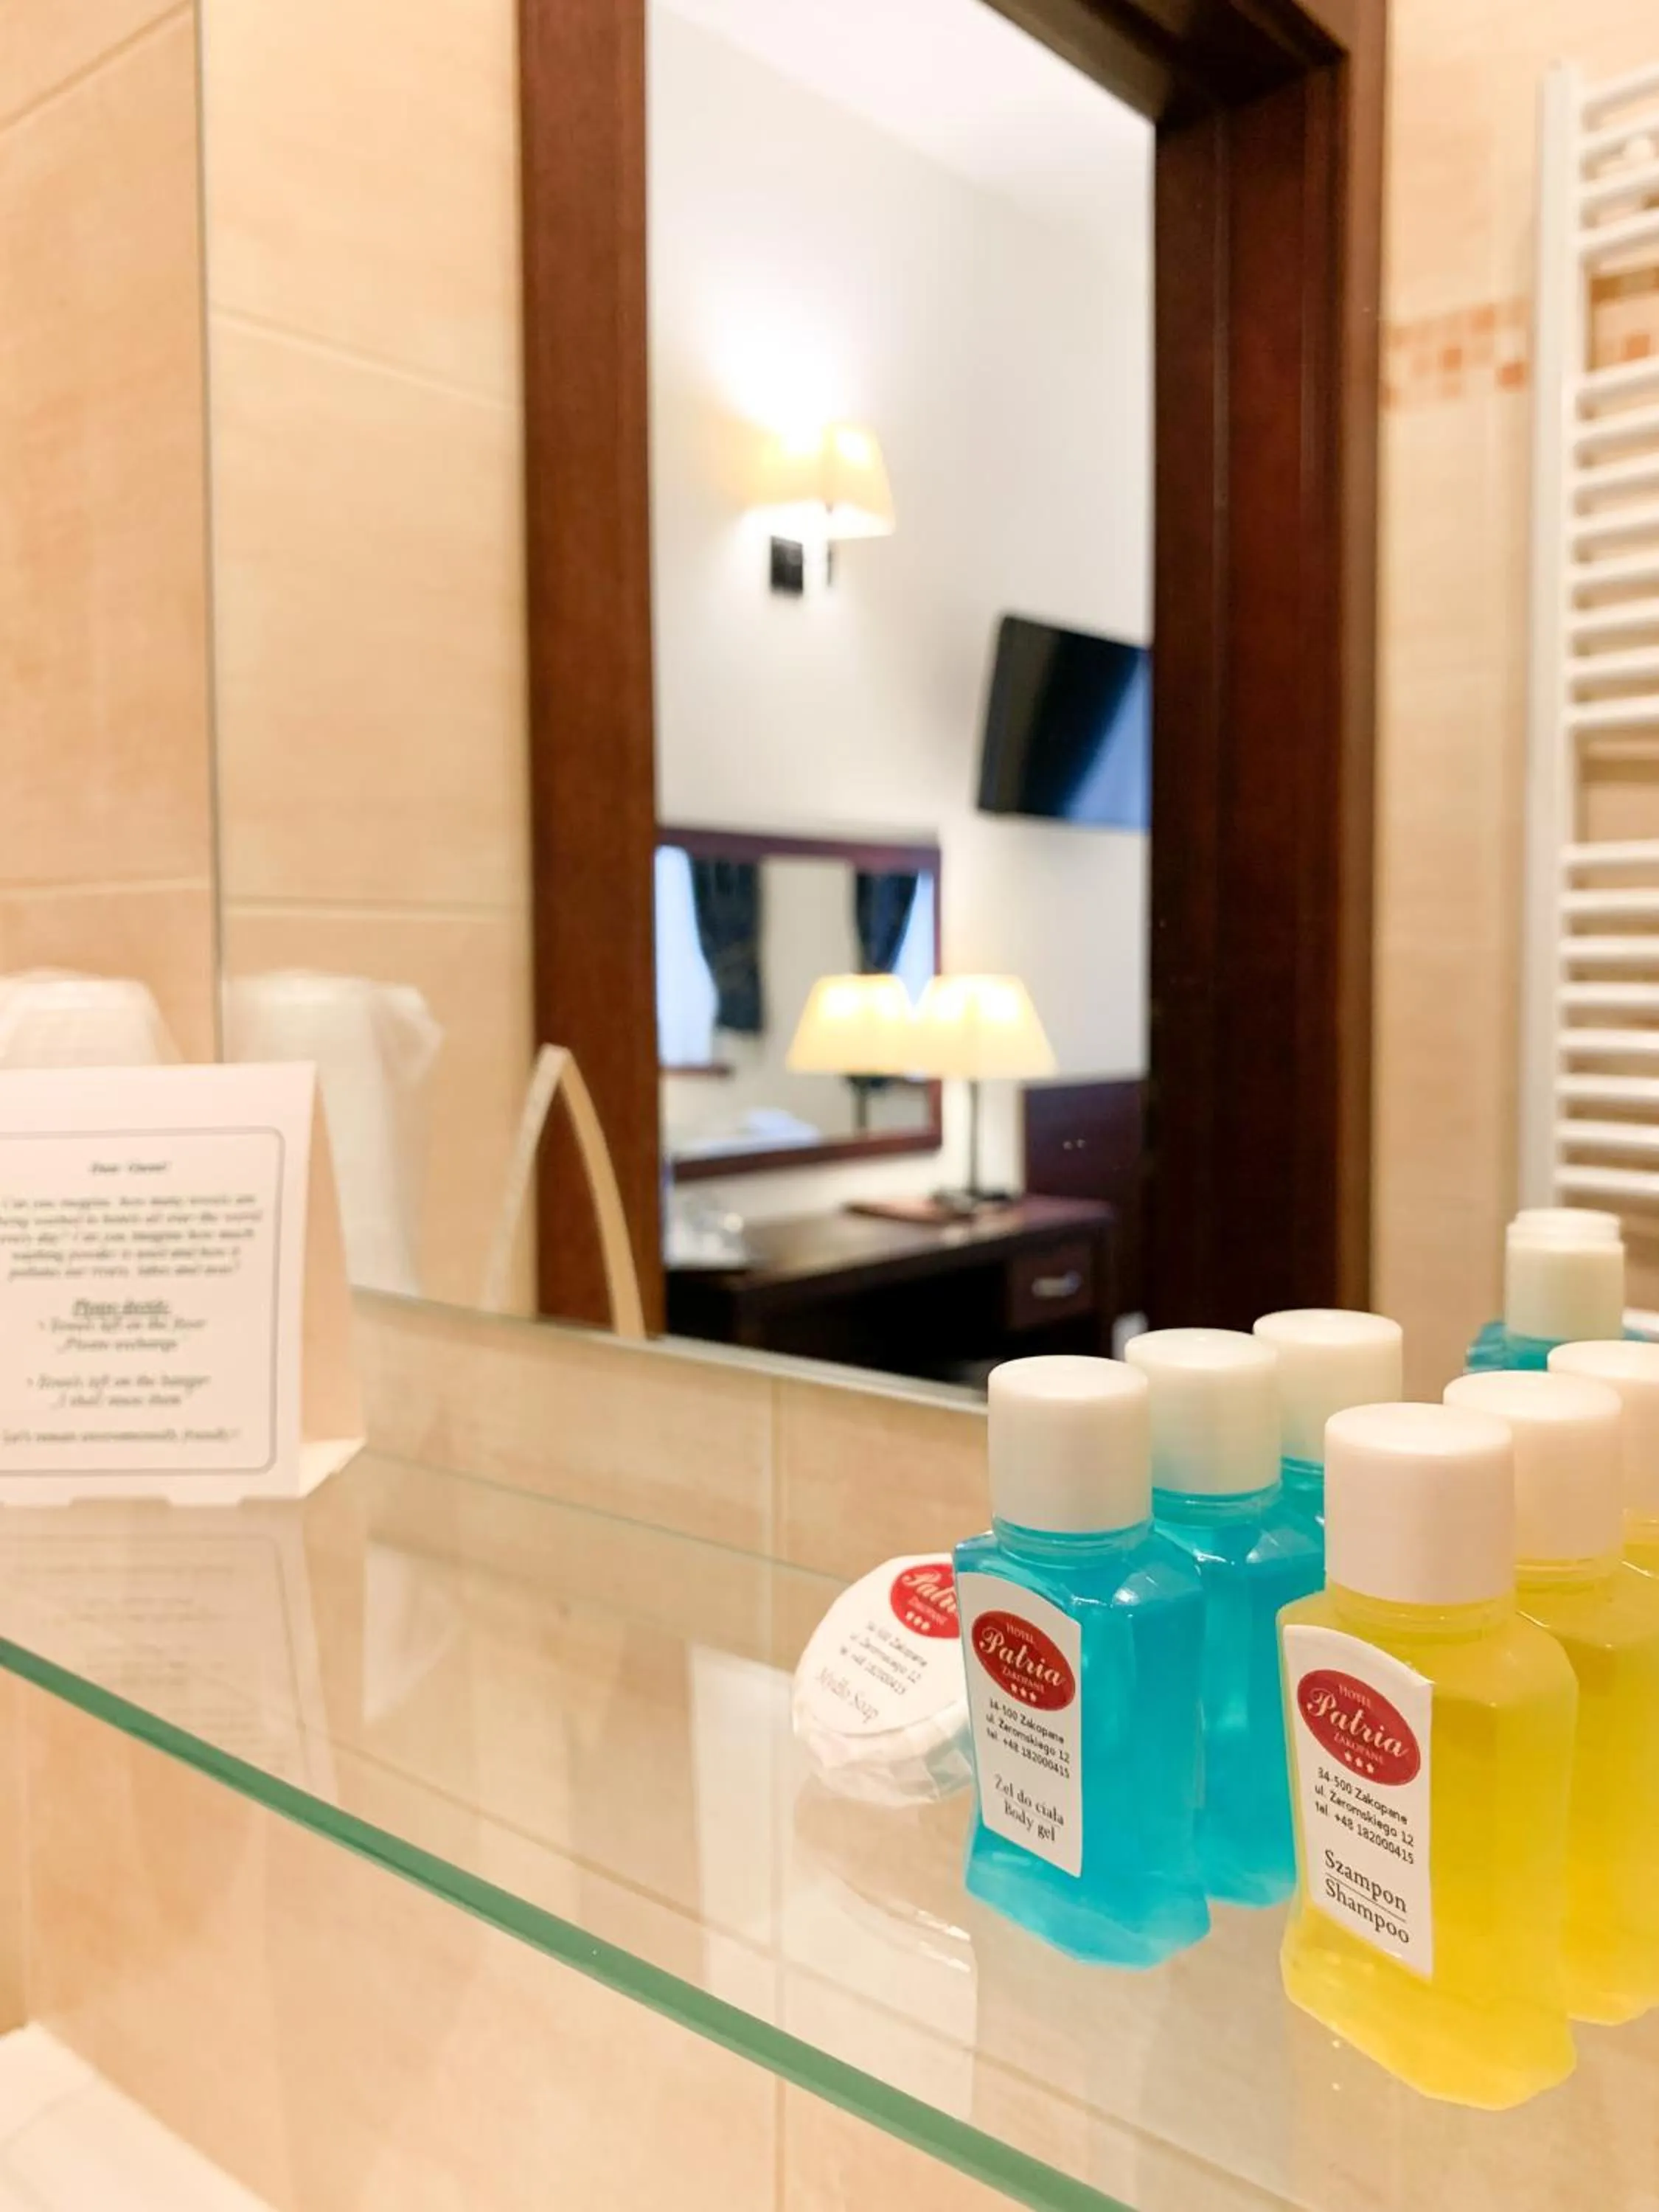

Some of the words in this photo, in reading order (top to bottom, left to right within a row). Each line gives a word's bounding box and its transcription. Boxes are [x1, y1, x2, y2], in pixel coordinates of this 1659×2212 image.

[979, 1626, 1066, 1687] Patria
[1020, 1713, 1064, 1745] Zakopane
[1307, 1687, 1409, 1758] Patria
[1059, 1749, 1070, 1764] 12
[1004, 1798, 1034, 1832] Body
[1038, 1824, 1055, 1842] gel
[1017, 1790, 1032, 1808] do
[1355, 1787, 1408, 1825] Zakopane
[1335, 1813, 1354, 1831] +48
[1357, 1823, 1414, 1865] 182000415
[1402, 1829, 1414, 1847] 12
[1325, 1849, 1407, 1913] Szampon
[1325, 1877, 1410, 1944] Shampoo
